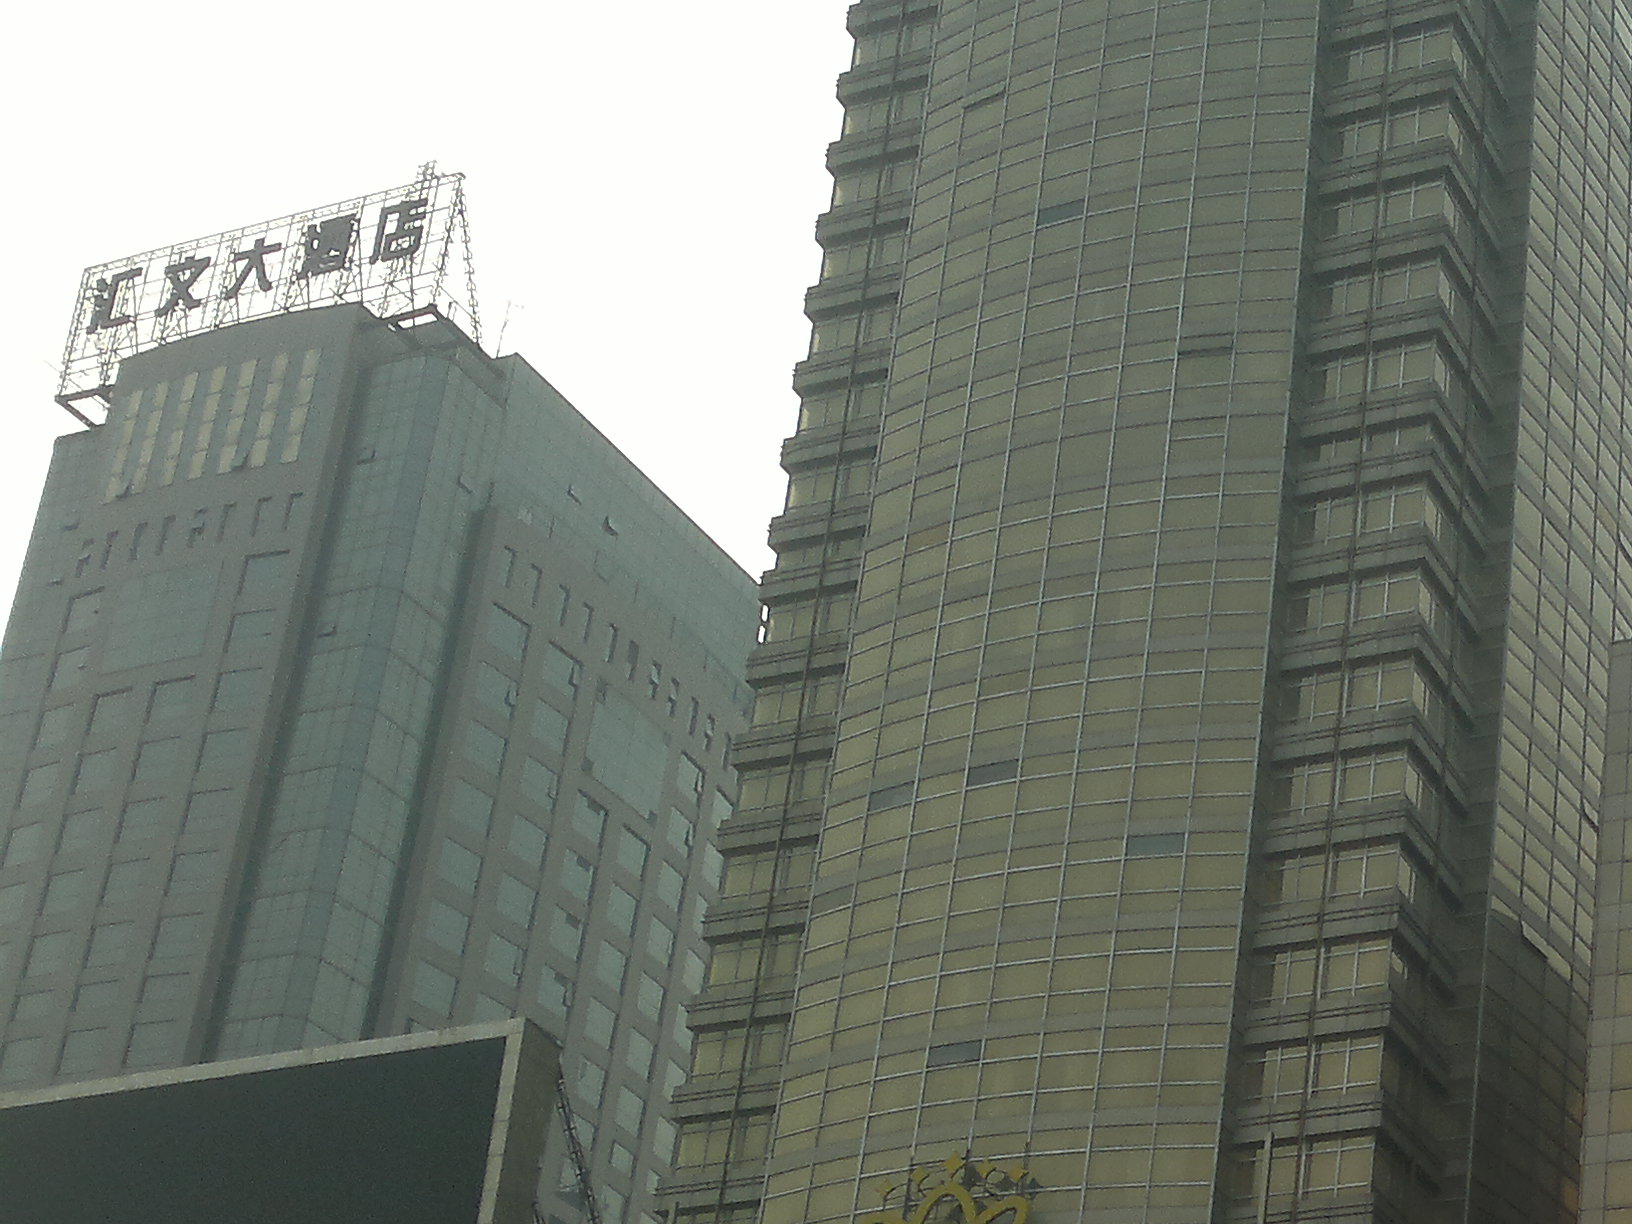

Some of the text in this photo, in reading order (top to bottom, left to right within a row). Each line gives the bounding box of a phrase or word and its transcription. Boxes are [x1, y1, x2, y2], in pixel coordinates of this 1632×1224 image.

[87, 198, 428, 335] 汇文大酒店
